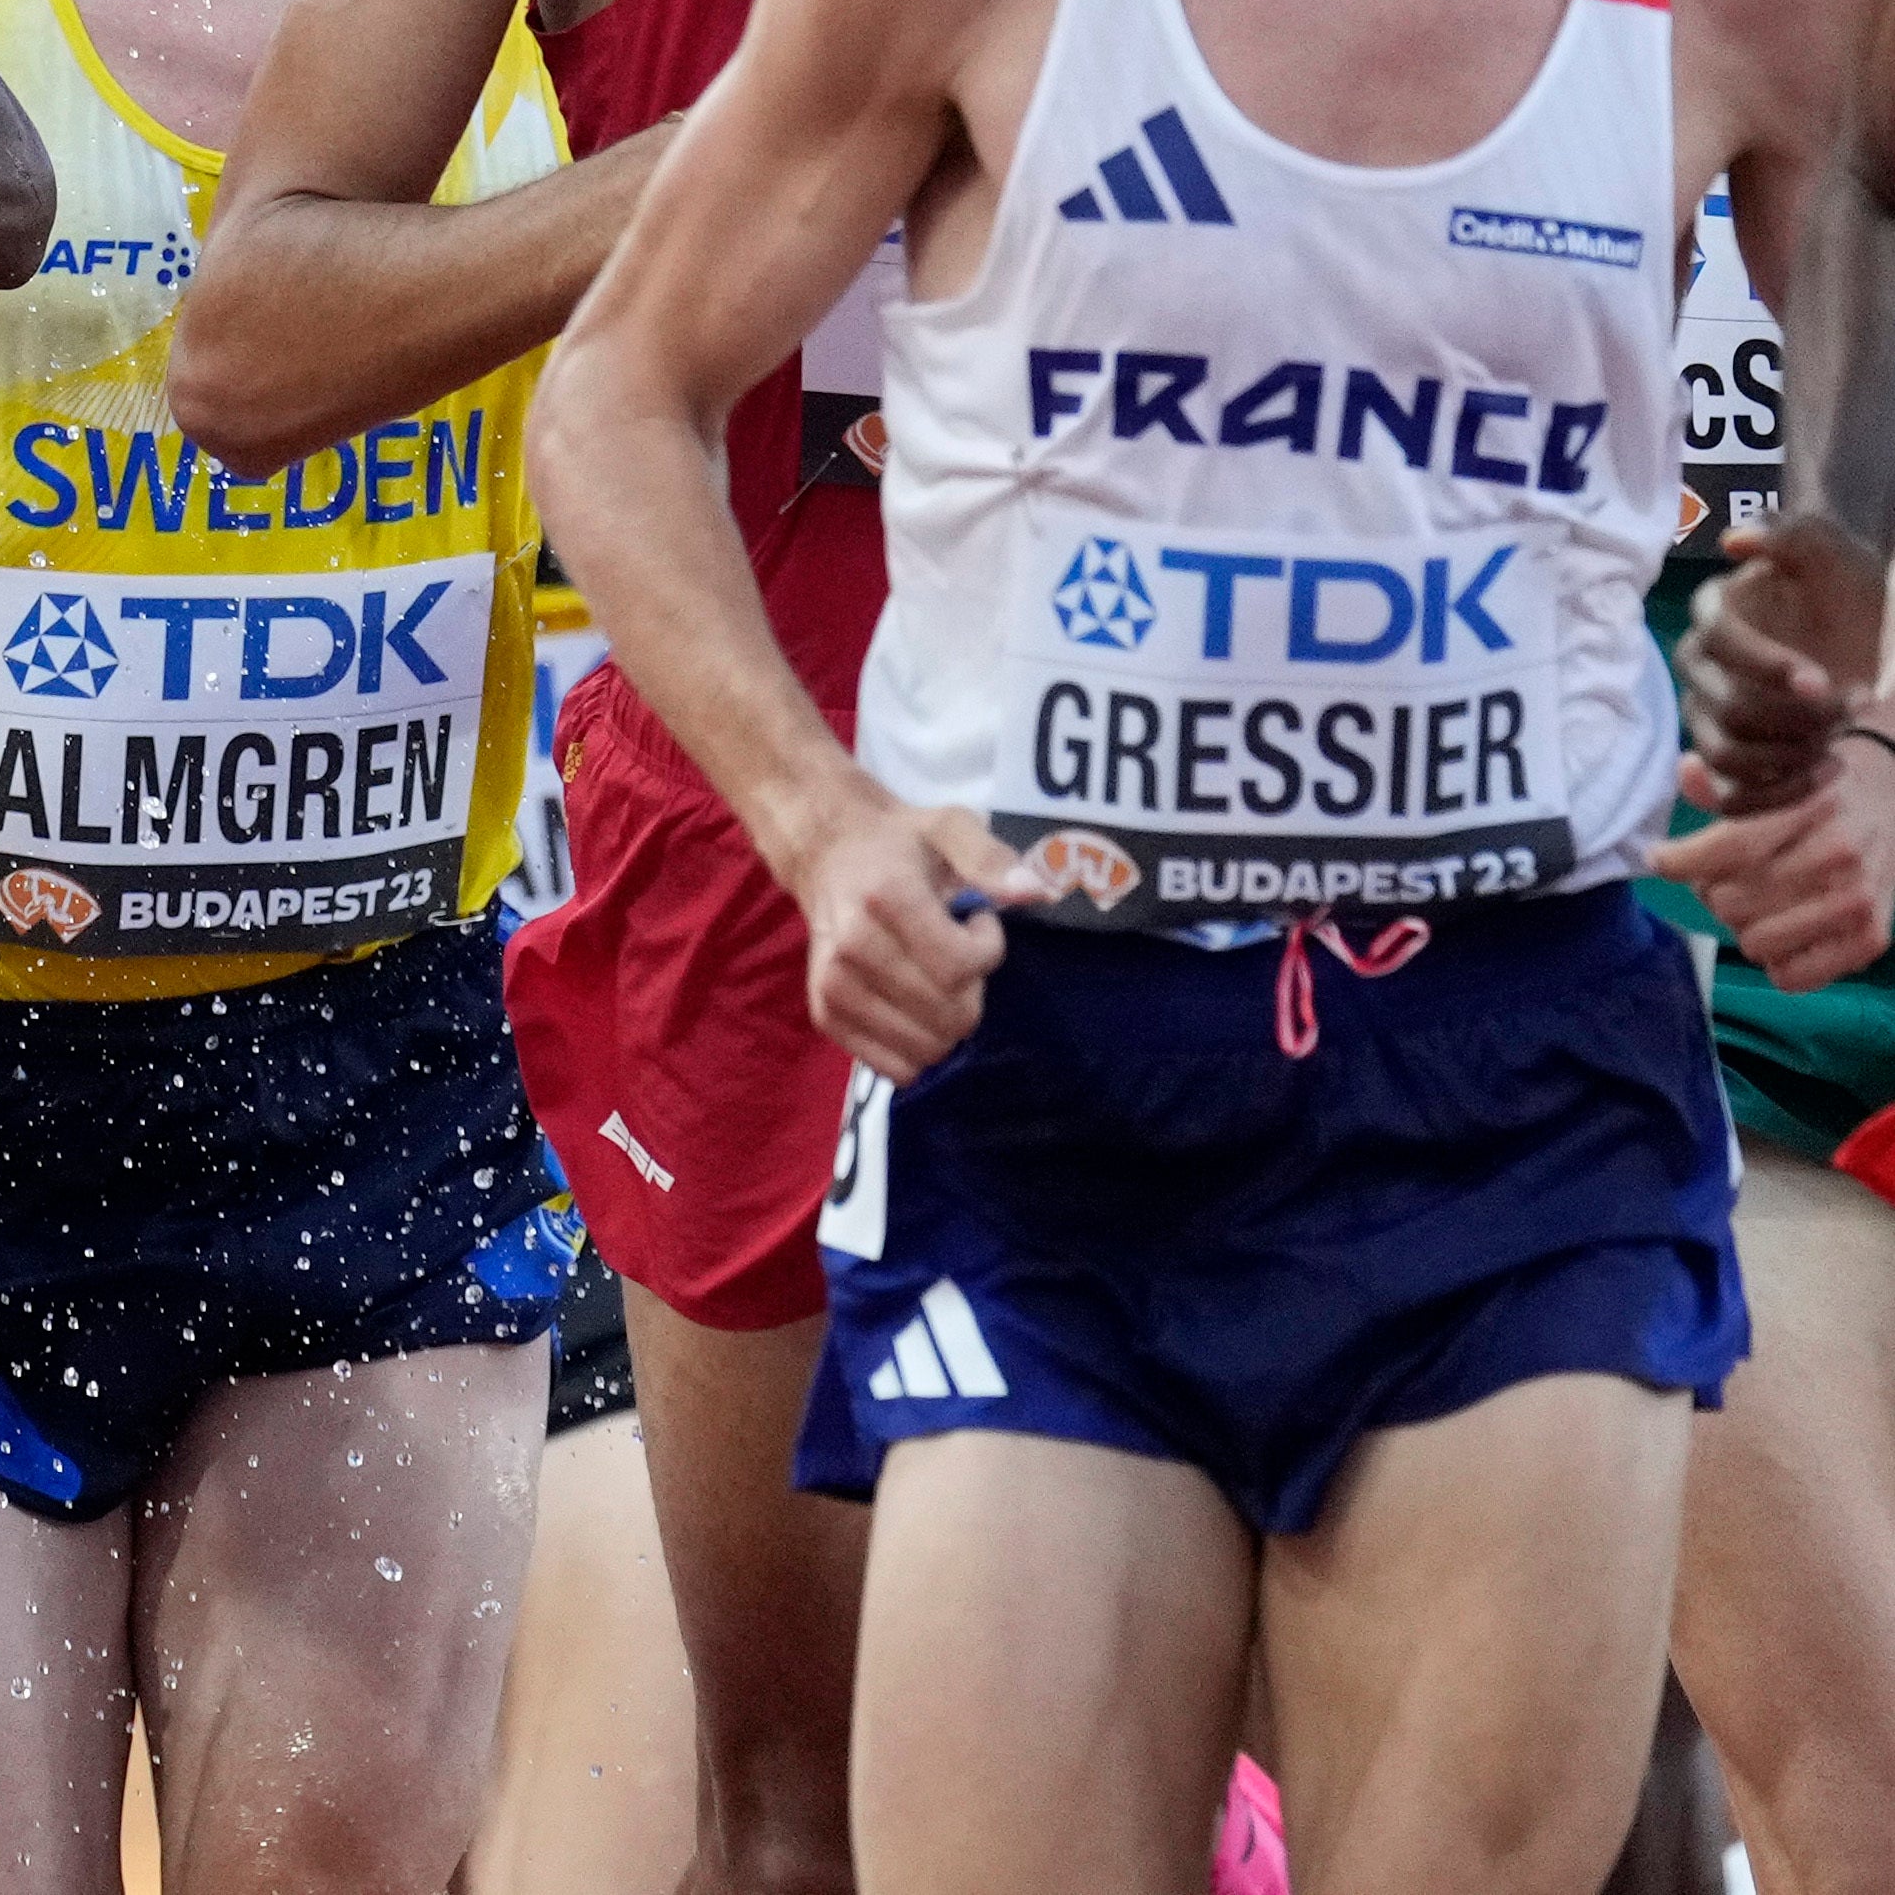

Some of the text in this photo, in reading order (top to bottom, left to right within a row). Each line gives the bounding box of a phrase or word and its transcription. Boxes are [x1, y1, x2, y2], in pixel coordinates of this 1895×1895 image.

[39, 239, 154, 276] AFT
[1028, 349, 1609, 495] FRANCE
[1679, 338, 1785, 451] cS
[119, 580, 455, 702] TDK
[1161, 543, 1520, 666] TDK
[1034, 681, 1531, 818] GRESSIER
